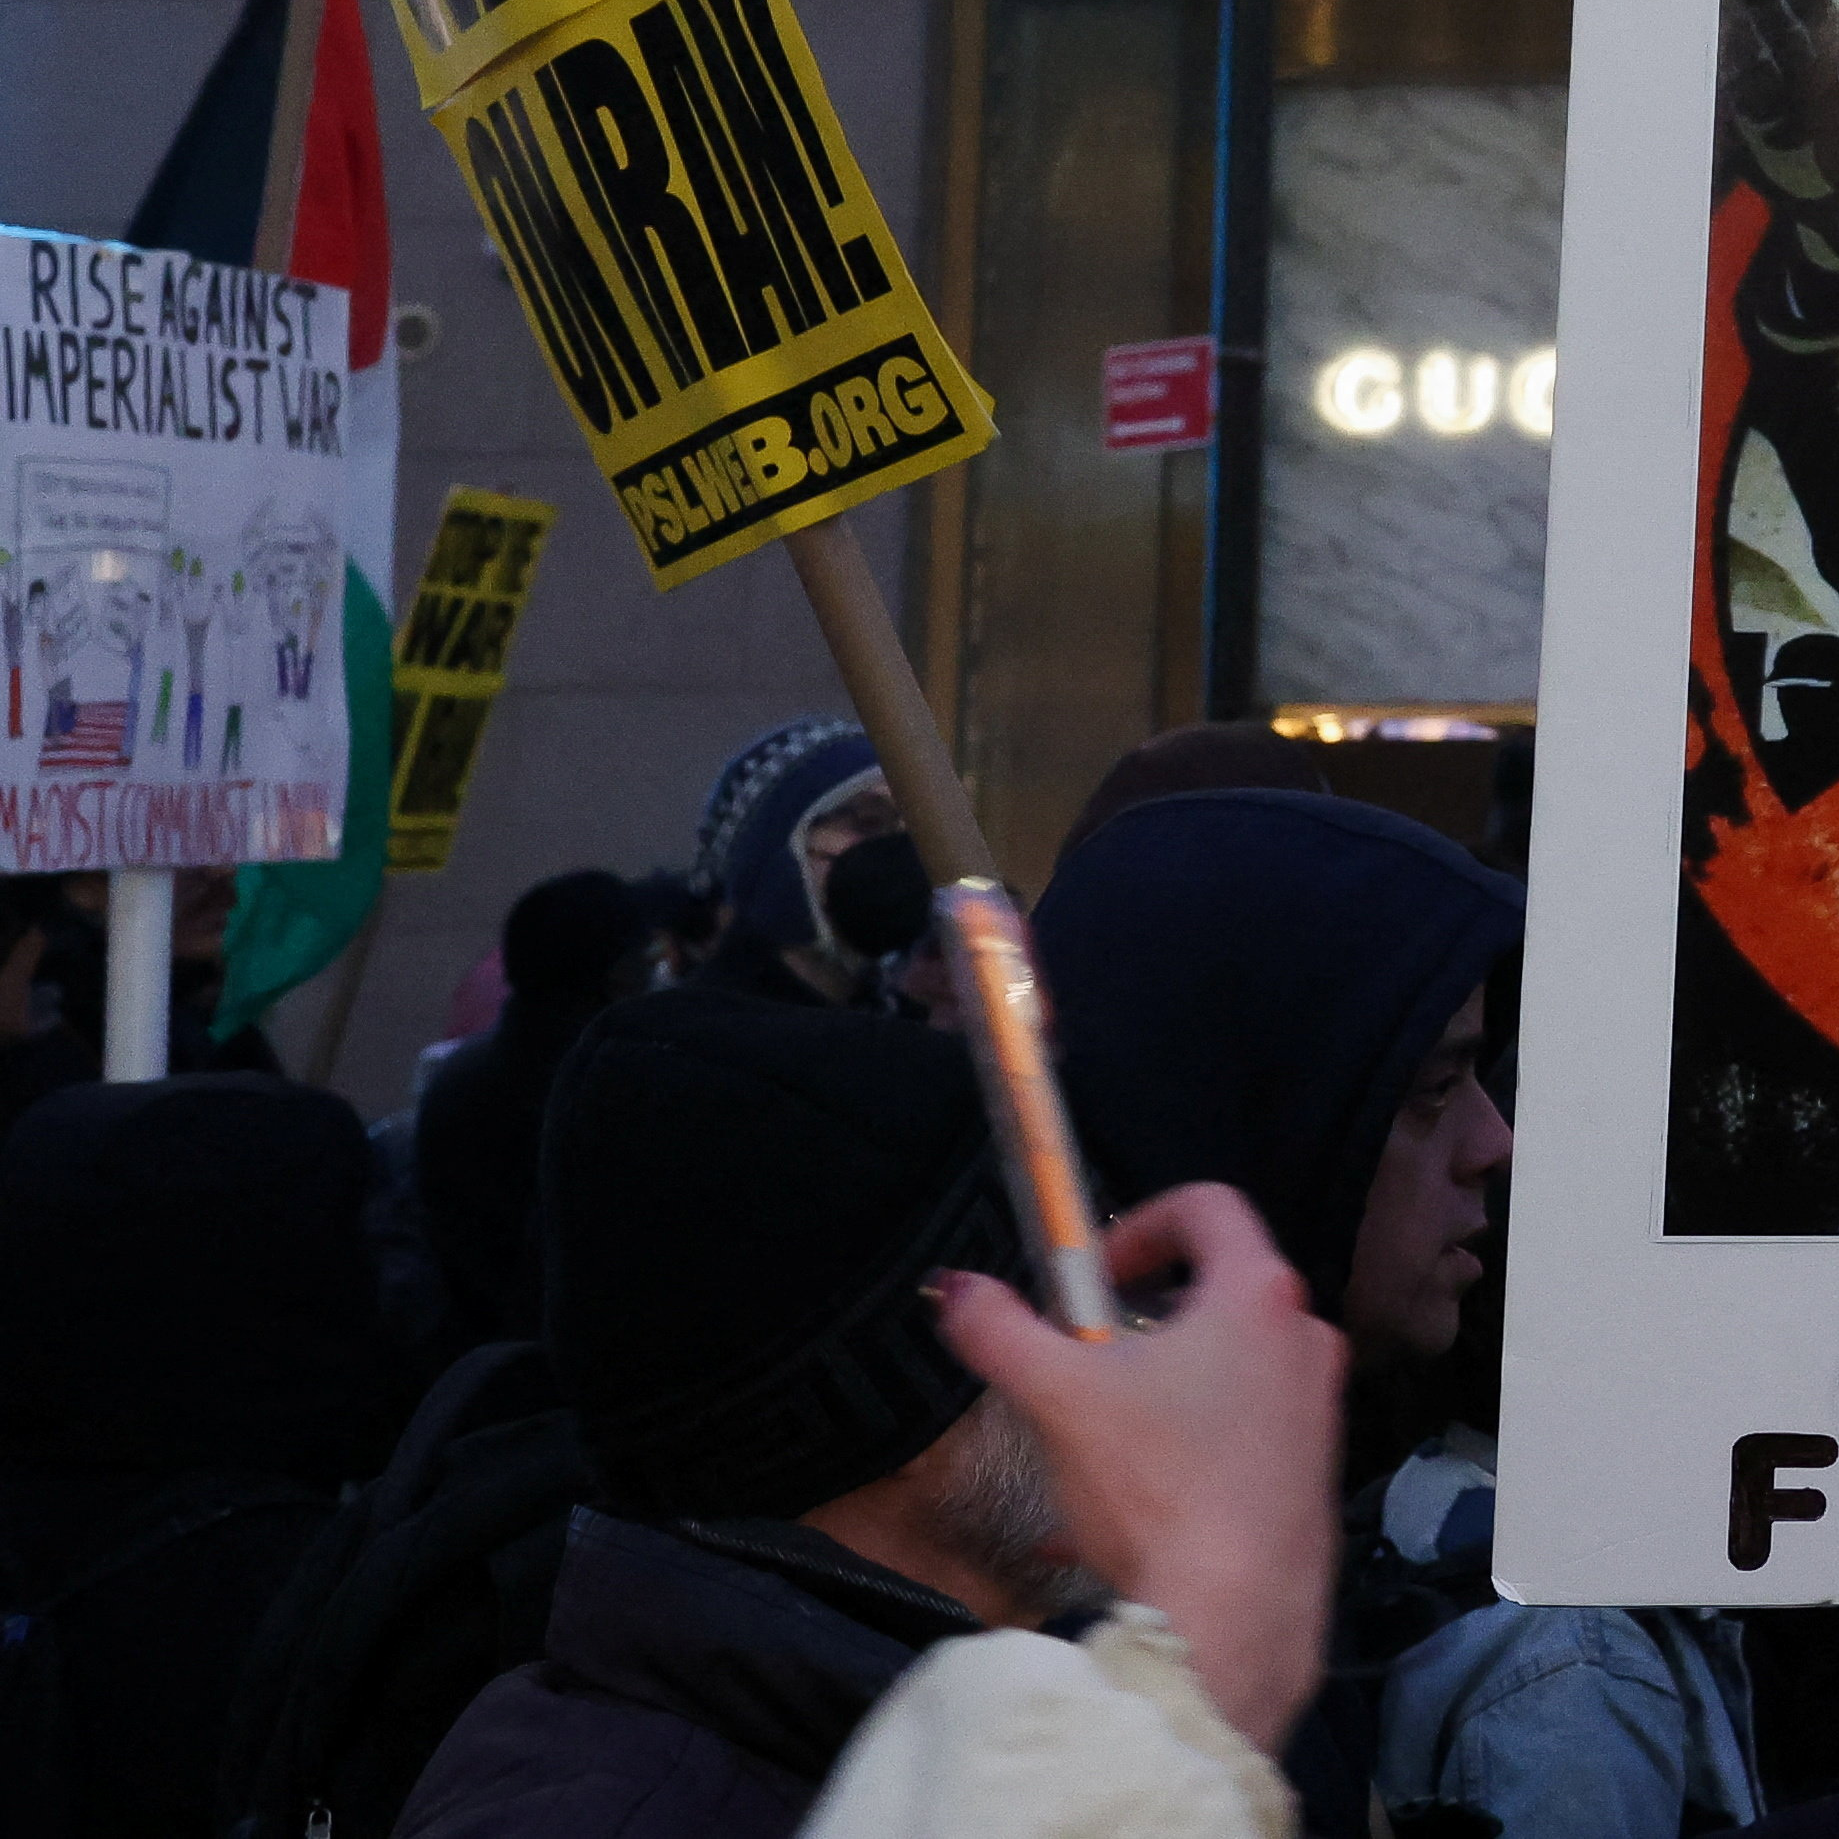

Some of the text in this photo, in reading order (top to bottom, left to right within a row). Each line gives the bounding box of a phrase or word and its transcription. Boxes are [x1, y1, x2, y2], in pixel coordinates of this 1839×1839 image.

[30, 240, 318, 359] RISE AGAINST
[463, 88, 668, 435] ON
[2, 326, 343, 459] IMPERIALIST WAR
[625, 353, 955, 554] PSLWEB.ORG
[1319, 345, 1556, 436] GUC
